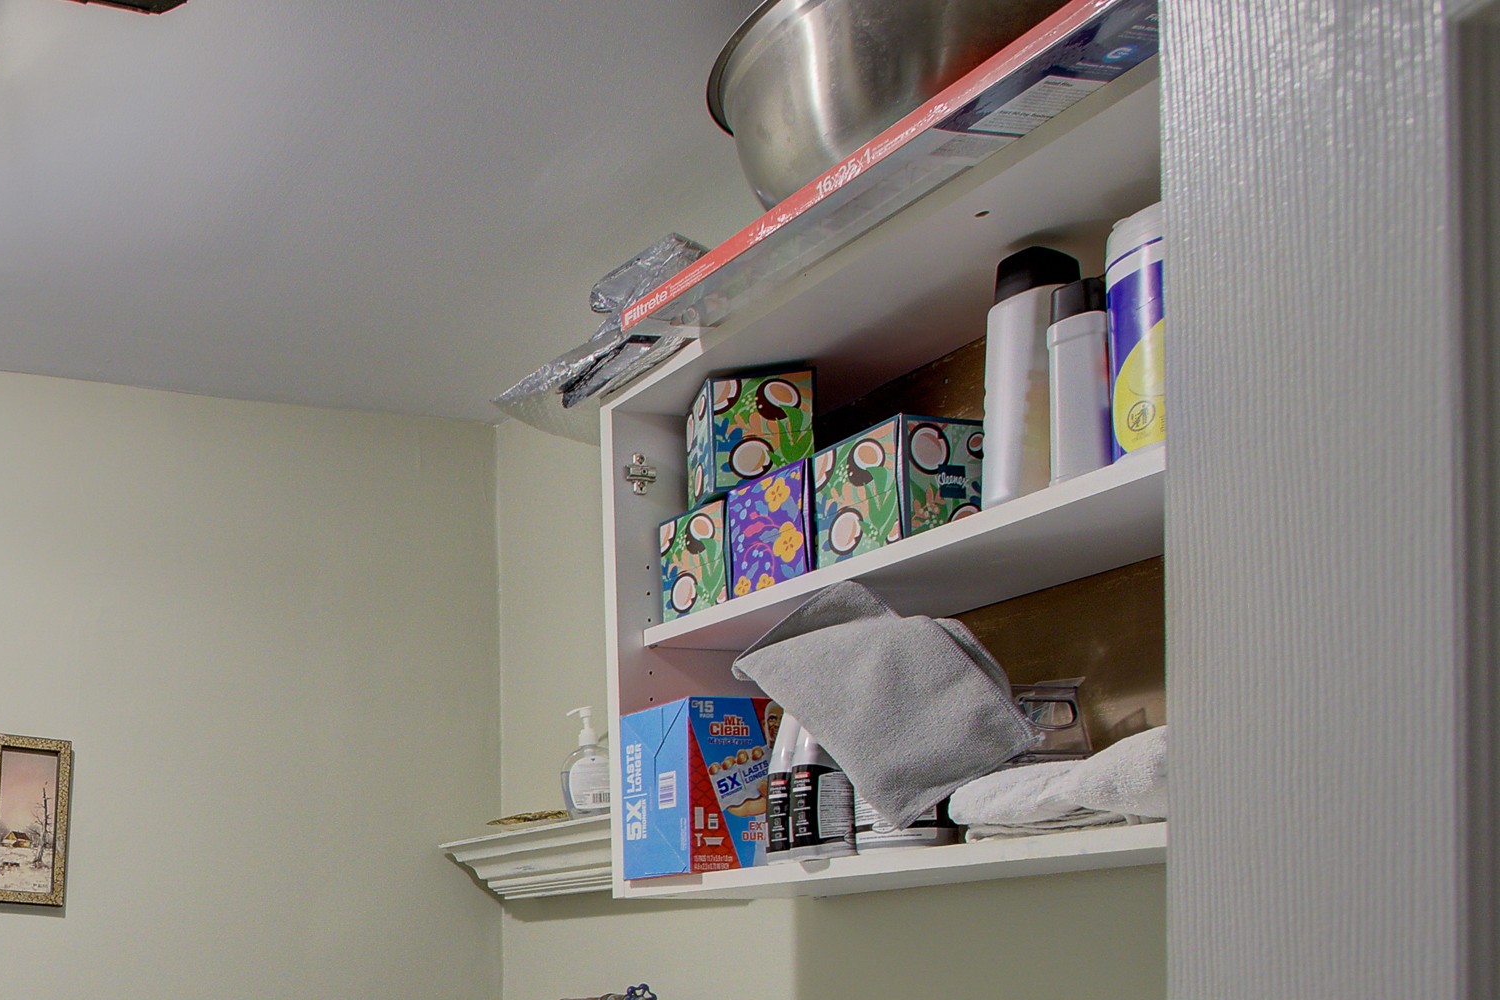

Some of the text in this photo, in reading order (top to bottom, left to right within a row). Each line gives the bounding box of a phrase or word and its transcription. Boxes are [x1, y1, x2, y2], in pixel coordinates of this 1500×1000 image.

[624, 290, 668, 326] Filtrete
[938, 472, 969, 488] Kleenex
[699, 700, 714, 713] 15
[723, 715, 745, 726] Mr.
[709, 722, 750, 737] Clean
[626, 744, 634, 793] LASTS
[634, 743, 642, 792] LONGER
[742, 760, 769, 777] LASTS
[716, 773, 742, 795] 5X
[626, 799, 642, 841] 5X
[742, 832, 766, 840] DUR
